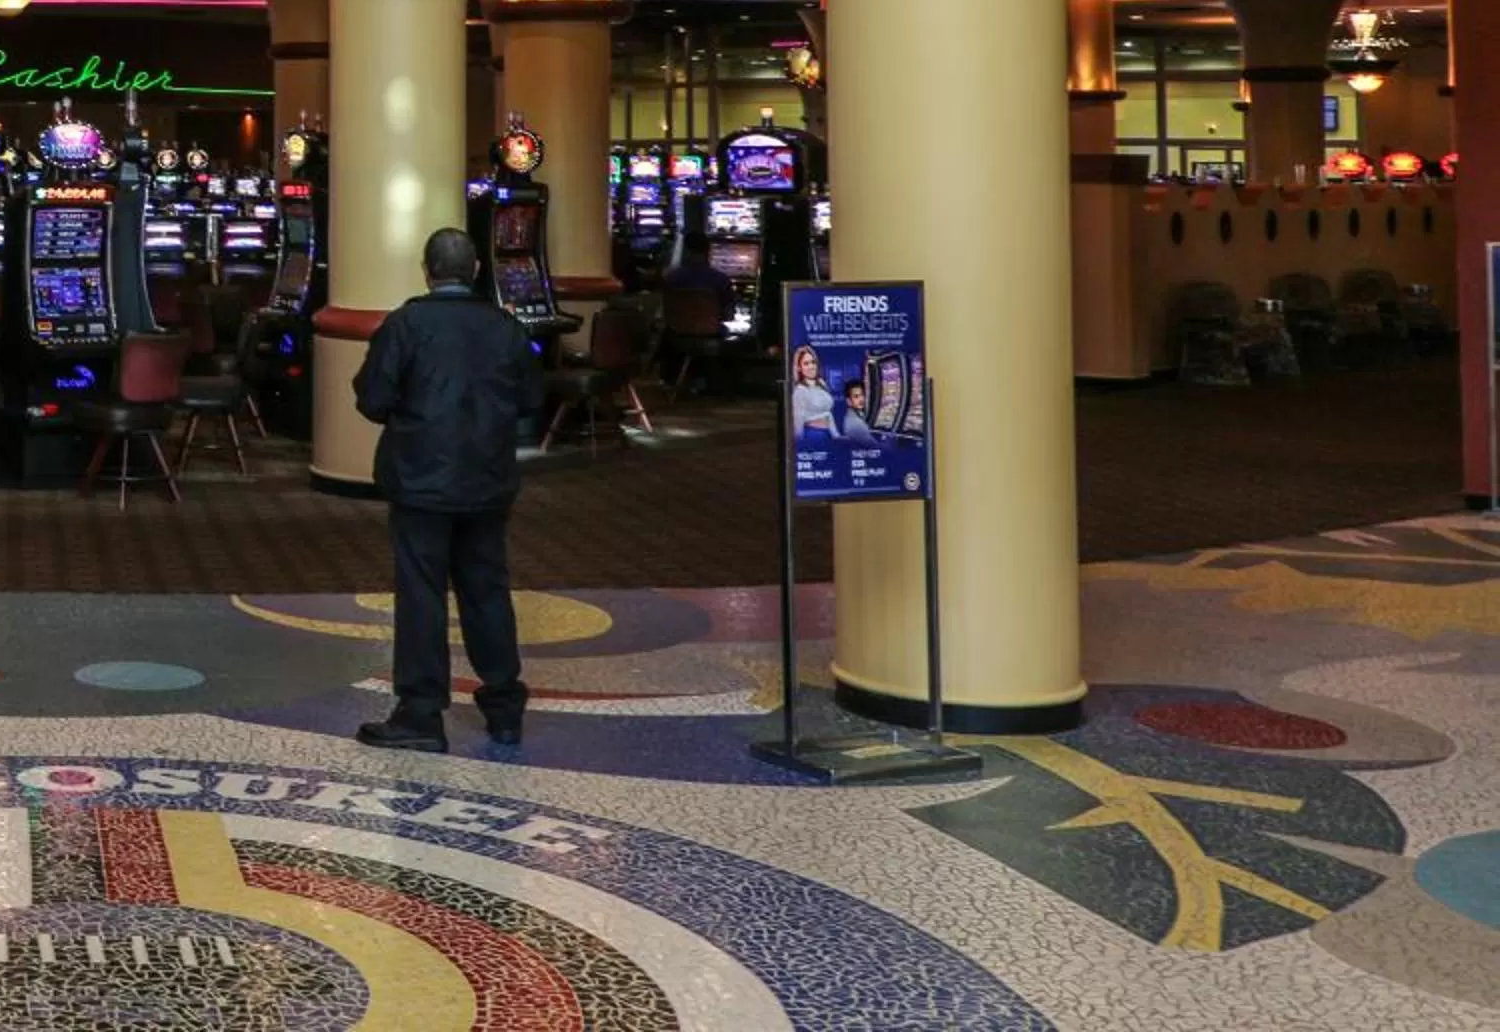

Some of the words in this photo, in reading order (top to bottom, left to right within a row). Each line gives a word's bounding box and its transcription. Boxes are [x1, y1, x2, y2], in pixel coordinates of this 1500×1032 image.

[824, 296, 889, 312] FRIENDS
[804, 314, 841, 331] WITH
[844, 313, 909, 330] BENEFITS
